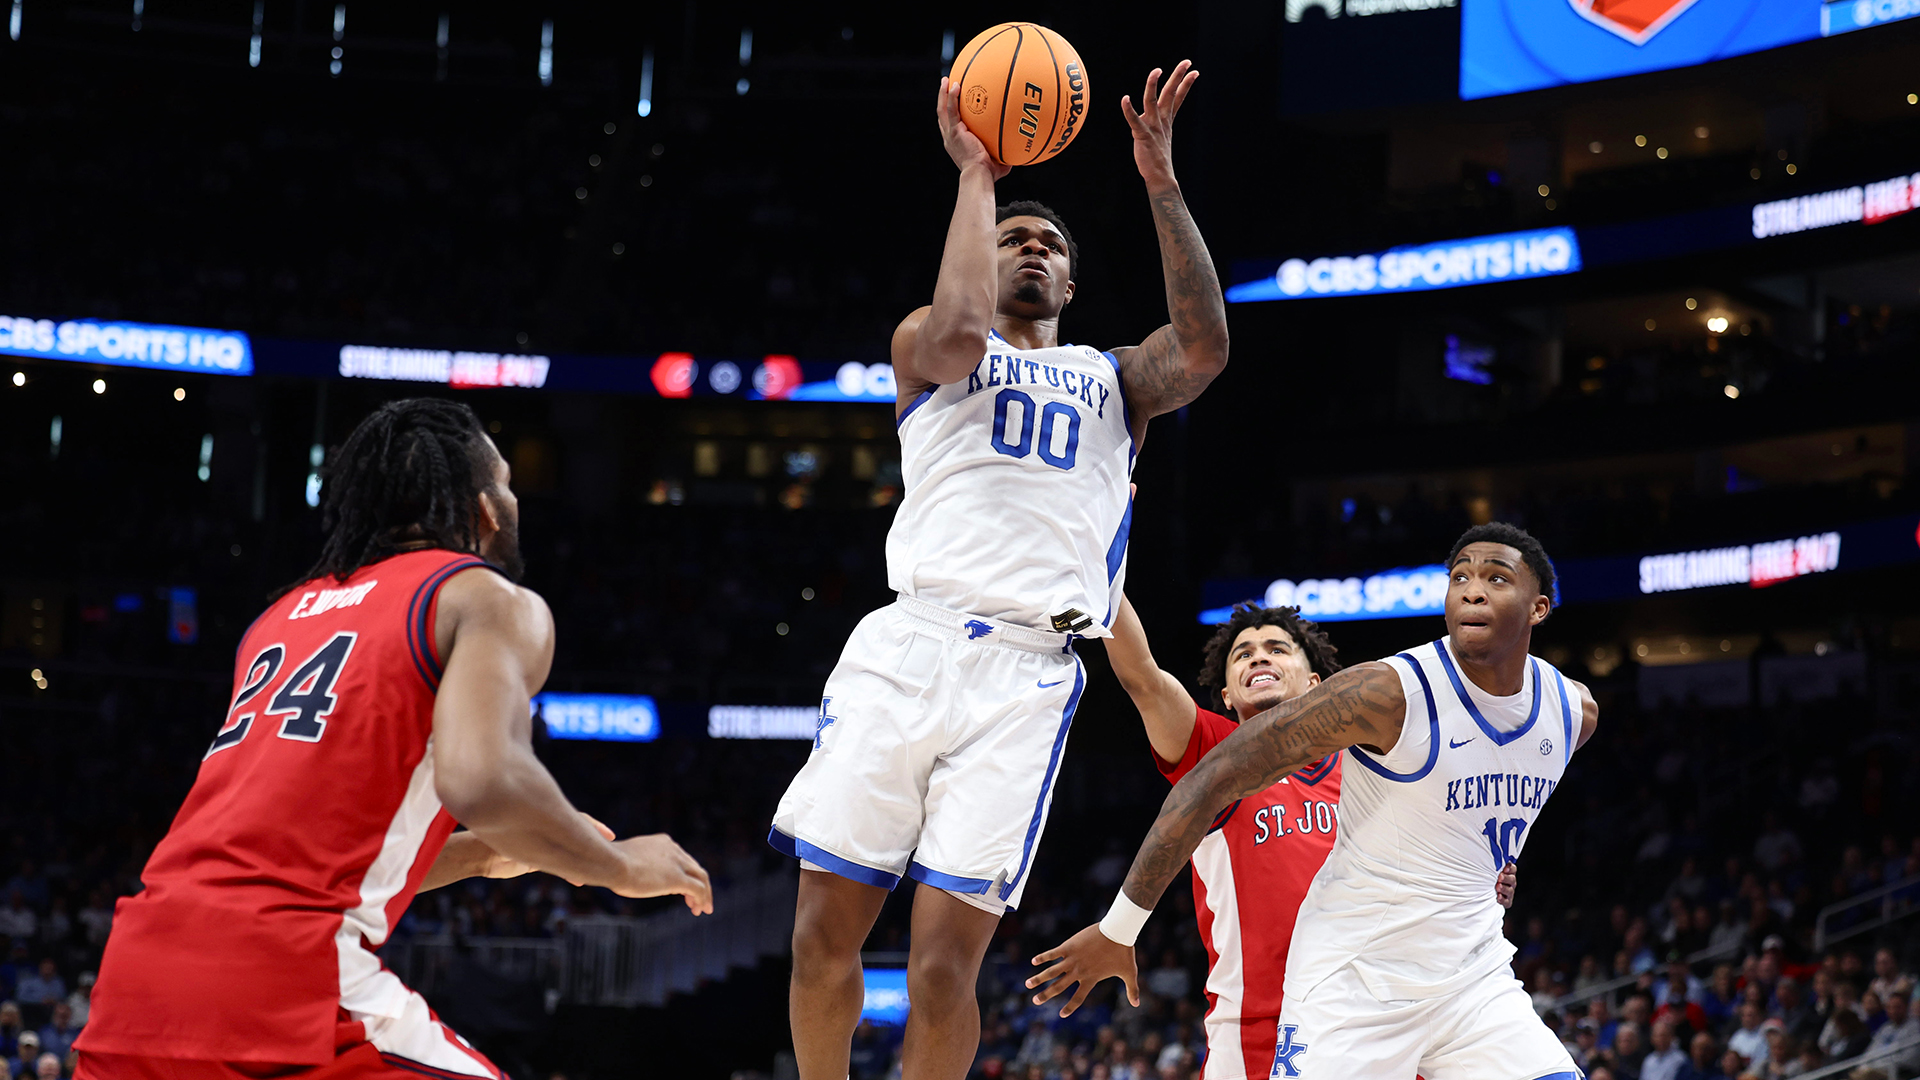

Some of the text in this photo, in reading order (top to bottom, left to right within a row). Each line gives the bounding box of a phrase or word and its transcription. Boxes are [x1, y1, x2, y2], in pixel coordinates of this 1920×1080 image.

[1018, 81, 1043, 139] EVO
[1047, 60, 1084, 155] Wilson
[1307, 234, 1571, 293] CBS SPORTS HQ
[57, 321, 187, 364] SPORTS
[188, 334, 244, 370] HQ
[339, 344, 450, 383] STREAMING
[967, 355, 1109, 419] KENTUCKY
[990, 388, 1081, 471] 00
[1639, 545, 1750, 593] STREAMING
[1295, 577, 1363, 615] CBS
[202, 631, 358, 762] 24
[601, 703, 653, 736] HQ
[1253, 805, 1293, 847] ST.
